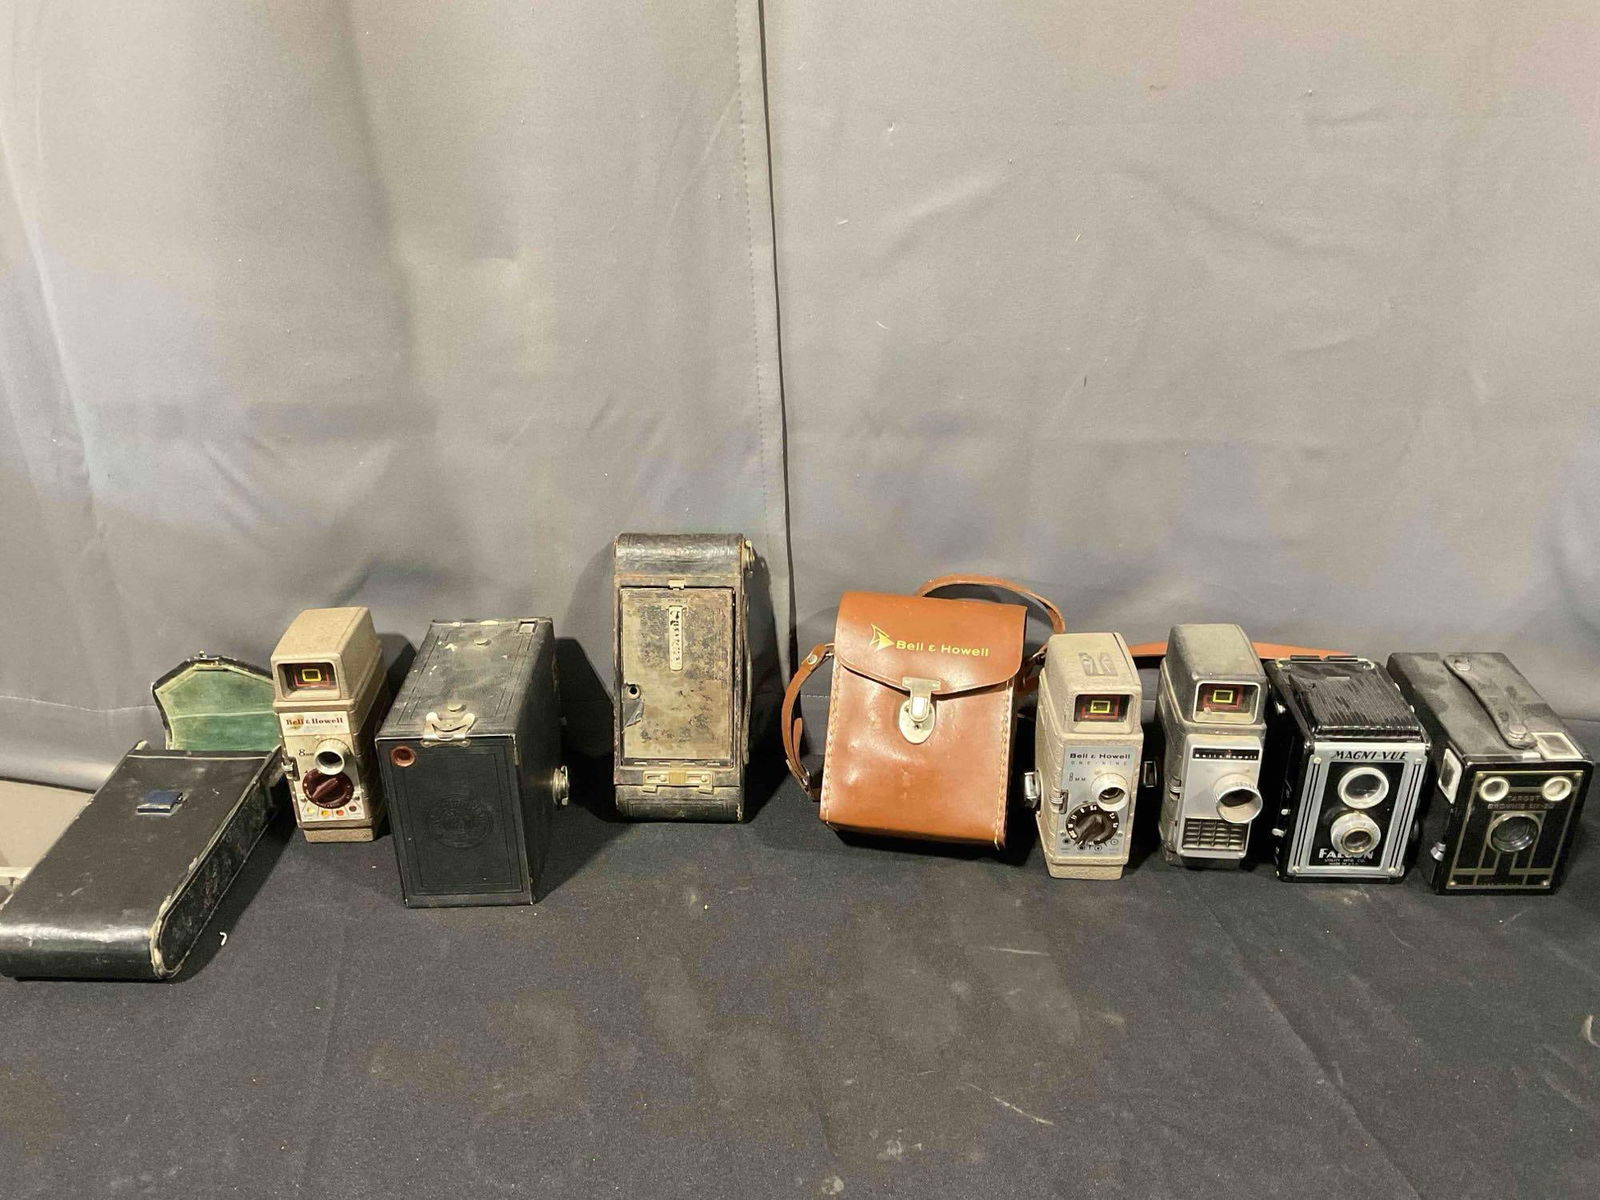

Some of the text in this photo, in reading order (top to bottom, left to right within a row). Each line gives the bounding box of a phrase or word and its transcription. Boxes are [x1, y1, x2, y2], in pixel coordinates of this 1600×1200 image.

[895, 640, 990, 658] Bell & Howell
[312, 717, 344, 725] Howell
[1330, 750, 1409, 760] MAGNI-VUE
